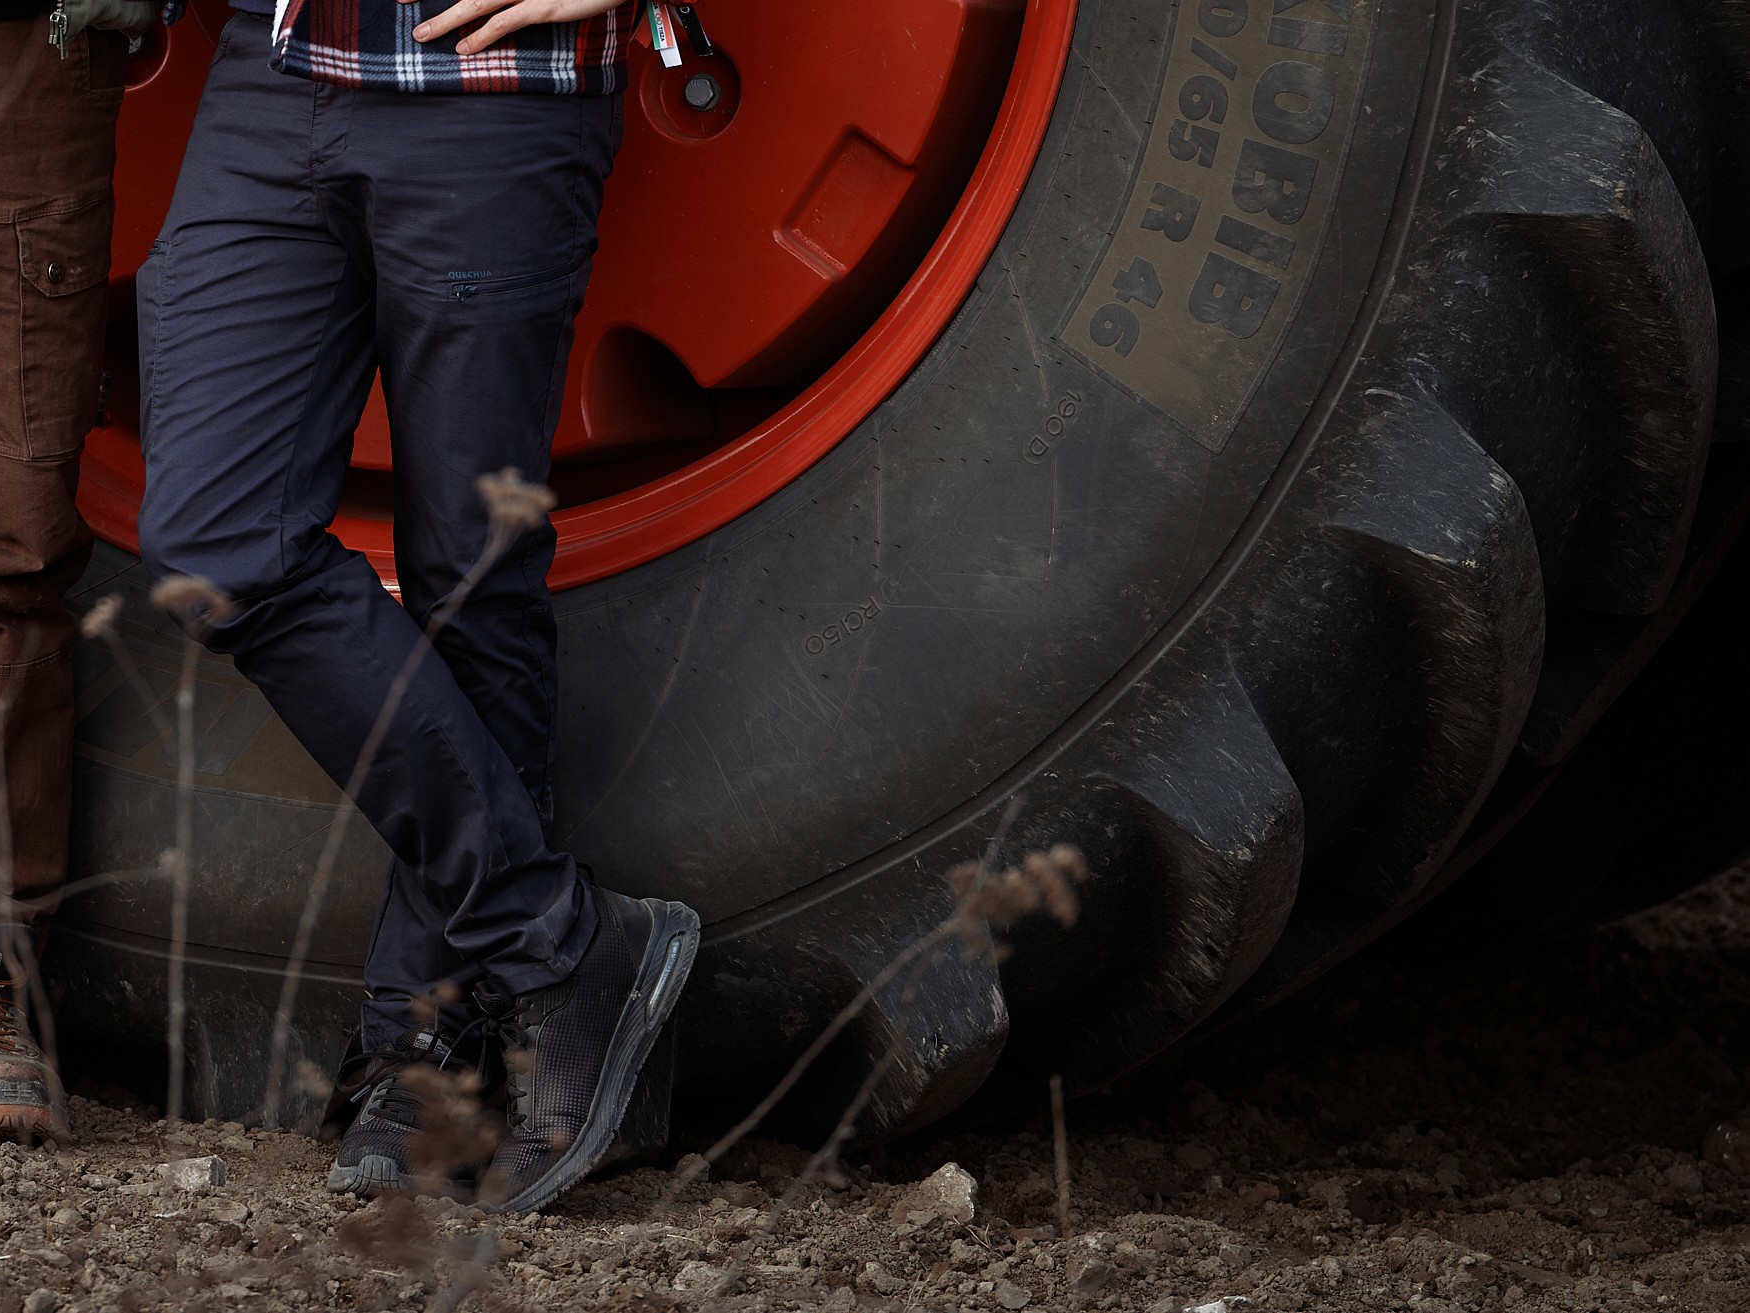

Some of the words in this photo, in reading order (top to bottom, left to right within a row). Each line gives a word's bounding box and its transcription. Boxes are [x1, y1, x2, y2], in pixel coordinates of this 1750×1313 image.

[1140, 181, 1202, 243] R
[448, 270, 492, 280] QUECHUA
[1089, 257, 1164, 357] 46
